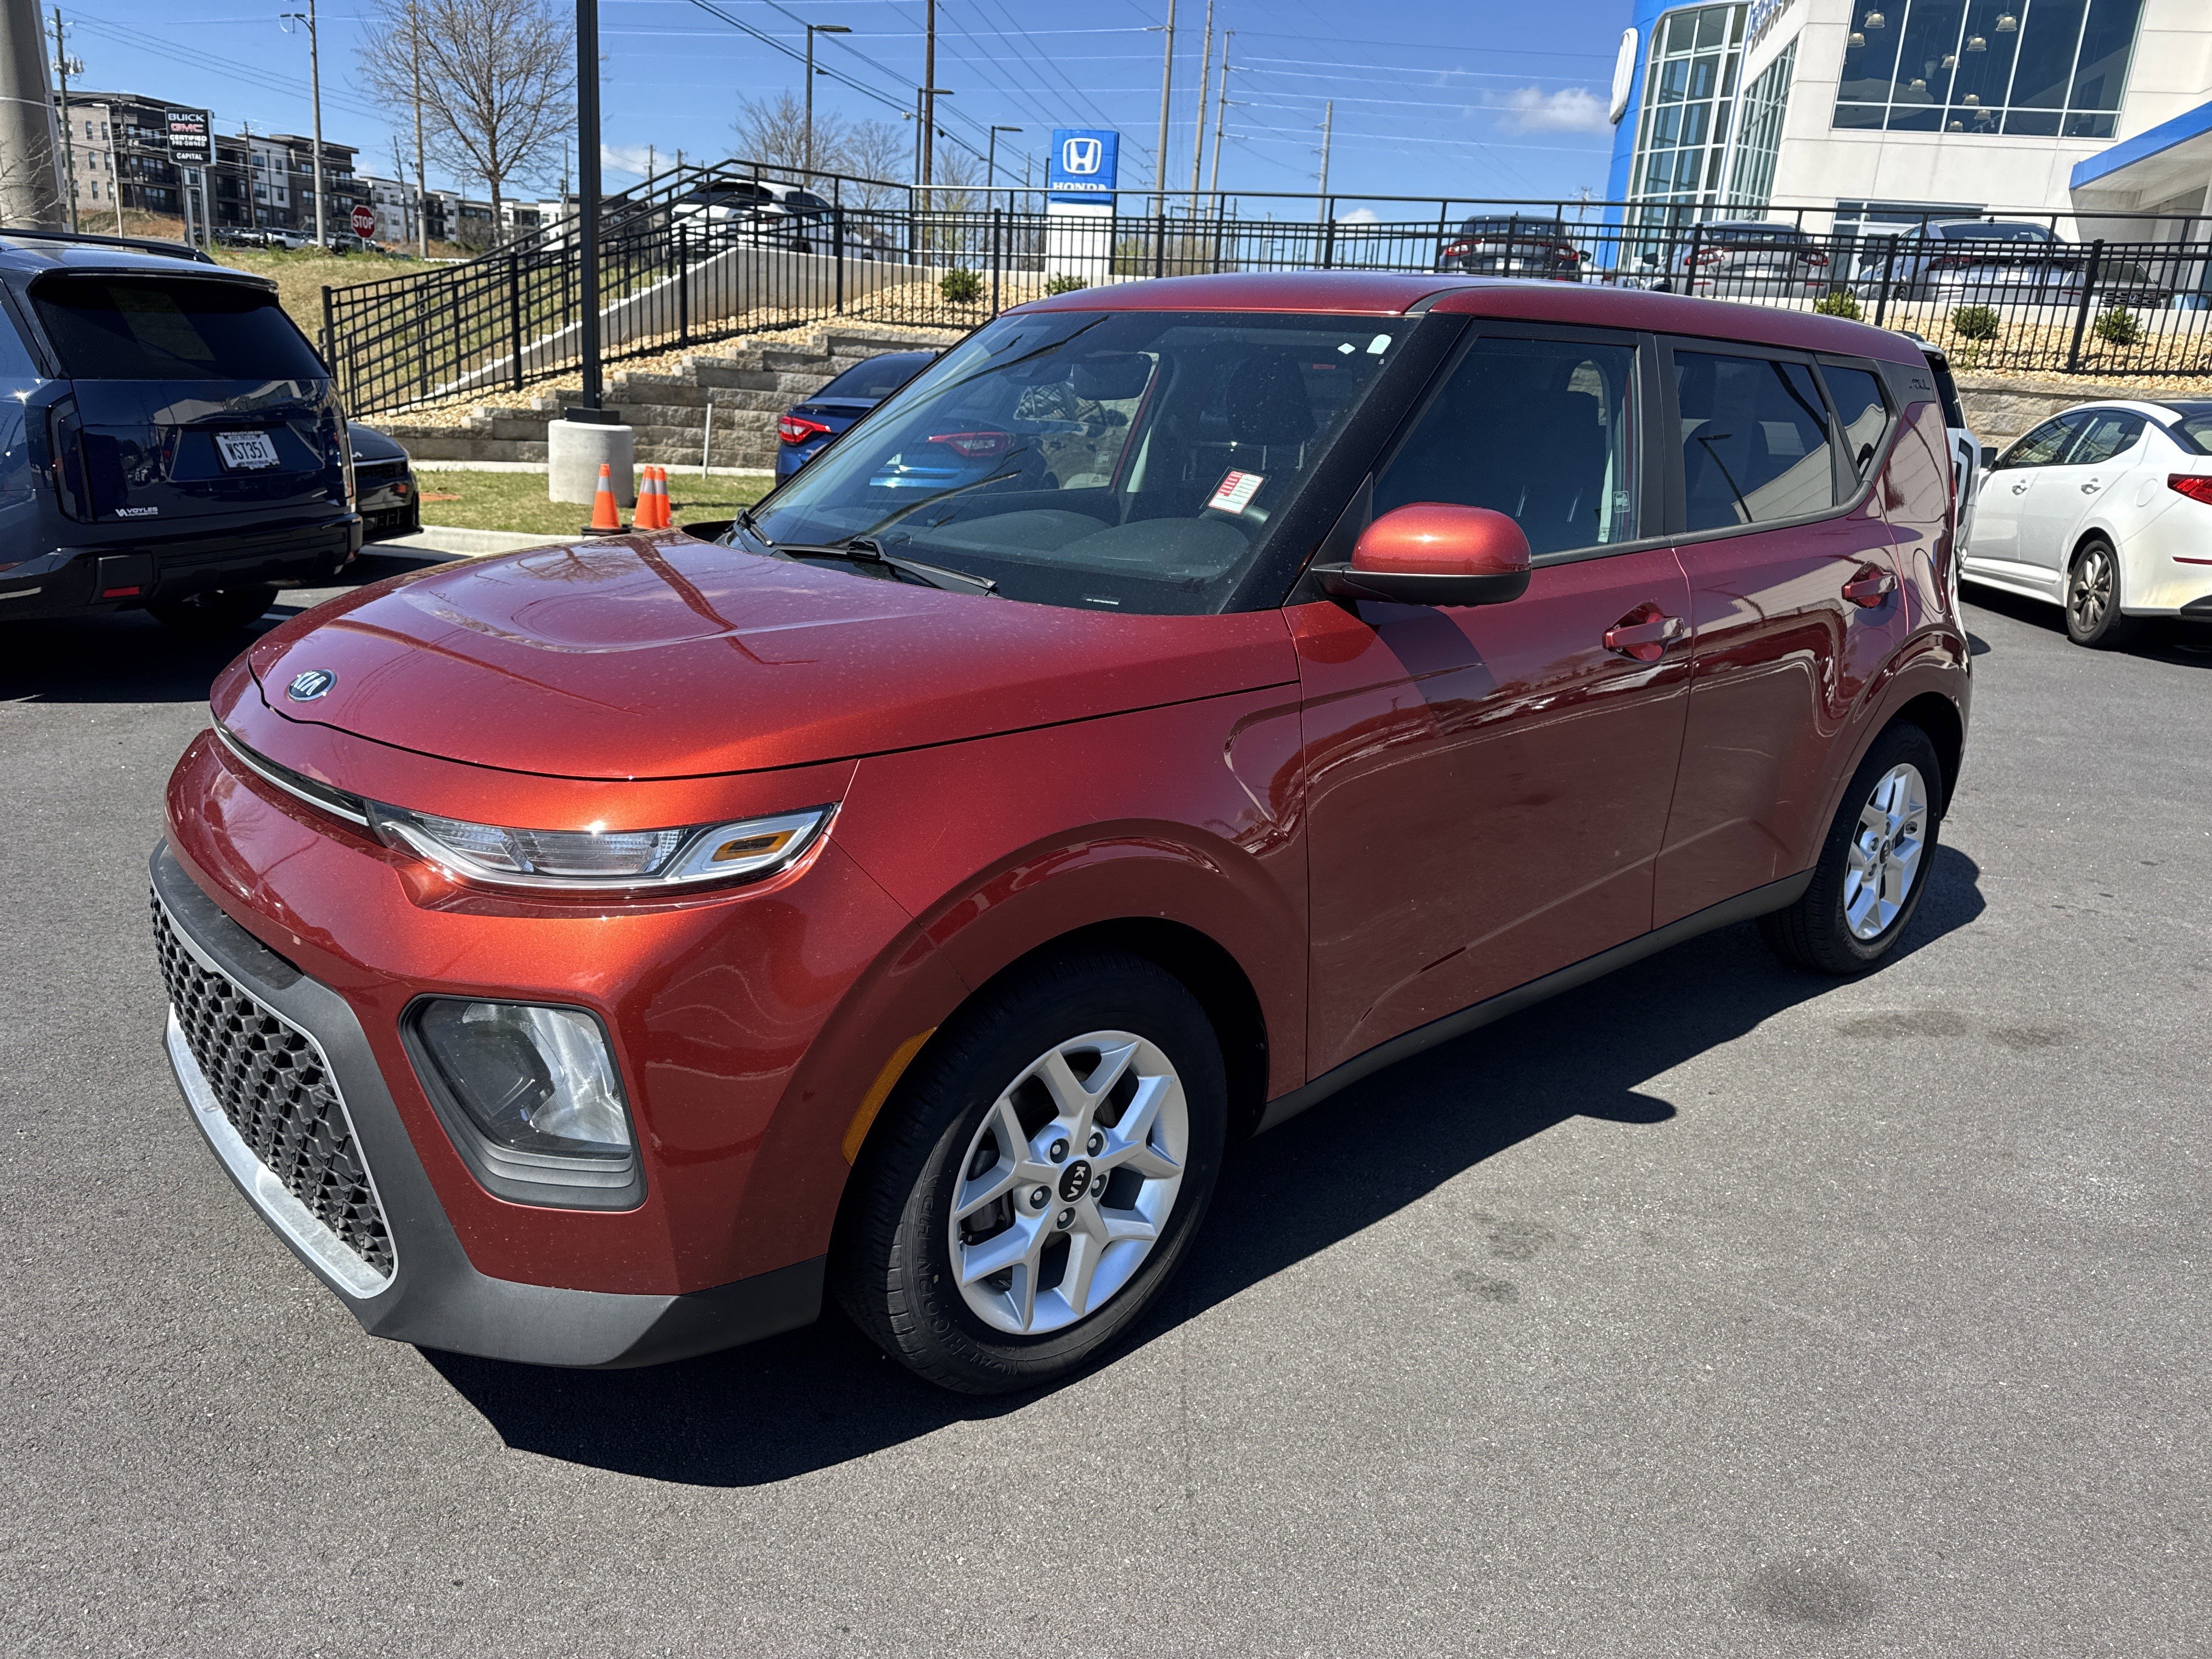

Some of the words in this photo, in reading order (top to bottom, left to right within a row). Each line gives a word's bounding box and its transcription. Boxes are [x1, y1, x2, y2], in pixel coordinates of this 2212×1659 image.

[168, 113, 205, 122] BUICK
[171, 123, 204, 133] GMC
[176, 153, 204, 161] CAPITAL
[1053, 182, 1107, 190] HONDA
[353, 215, 374, 229] STOP
[291, 671, 327, 696] KIA
[1066, 1166, 1086, 1198] KIA
